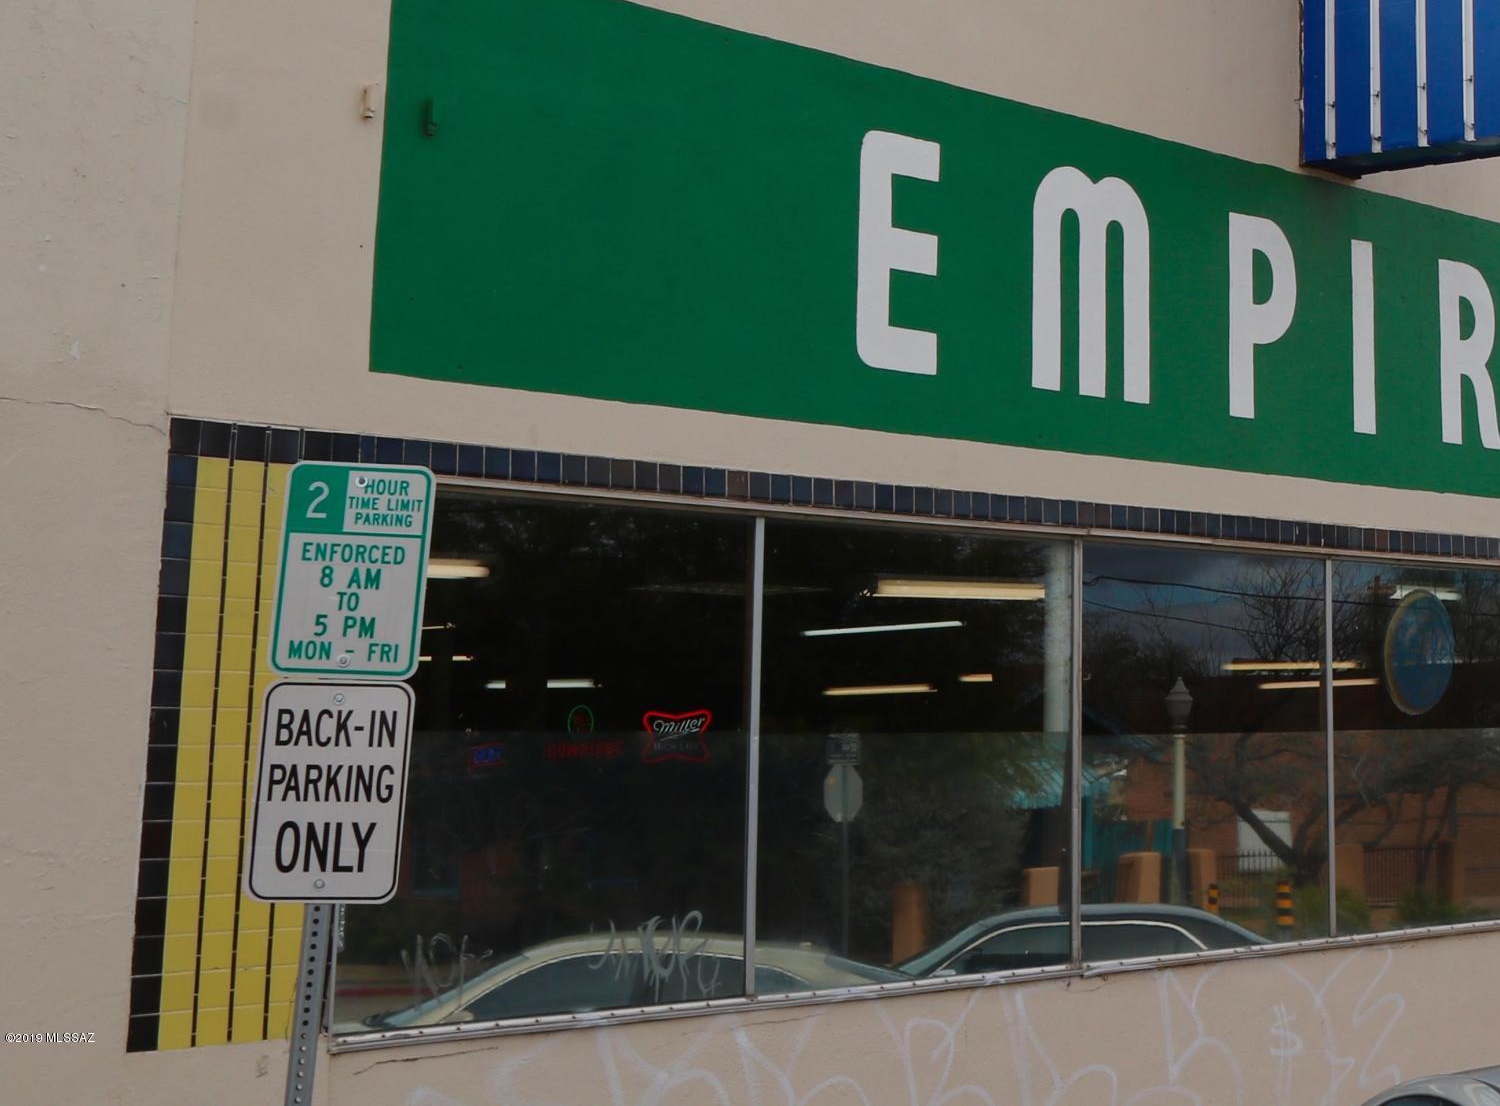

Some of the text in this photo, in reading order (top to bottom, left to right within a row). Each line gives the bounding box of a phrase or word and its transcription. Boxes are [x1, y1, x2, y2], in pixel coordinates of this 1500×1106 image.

[305, 480, 331, 520] 2
[365, 478, 409, 497] HOUR
[348, 495, 424, 513] TIME LIMIT
[354, 511, 413, 528] PARKING
[301, 541, 406, 566] ENFORCED
[320, 565, 382, 591] 8 AM
[336, 591, 360, 612] TO
[313, 614, 376, 639] 5 PM
[287, 639, 332, 661] MON
[367, 642, 399, 663] FRI
[274, 708, 398, 748] BACK-IN
[653, 717, 706, 740] Miller
[266, 764, 395, 804] PARKING
[275, 821, 377, 873] ONLY
